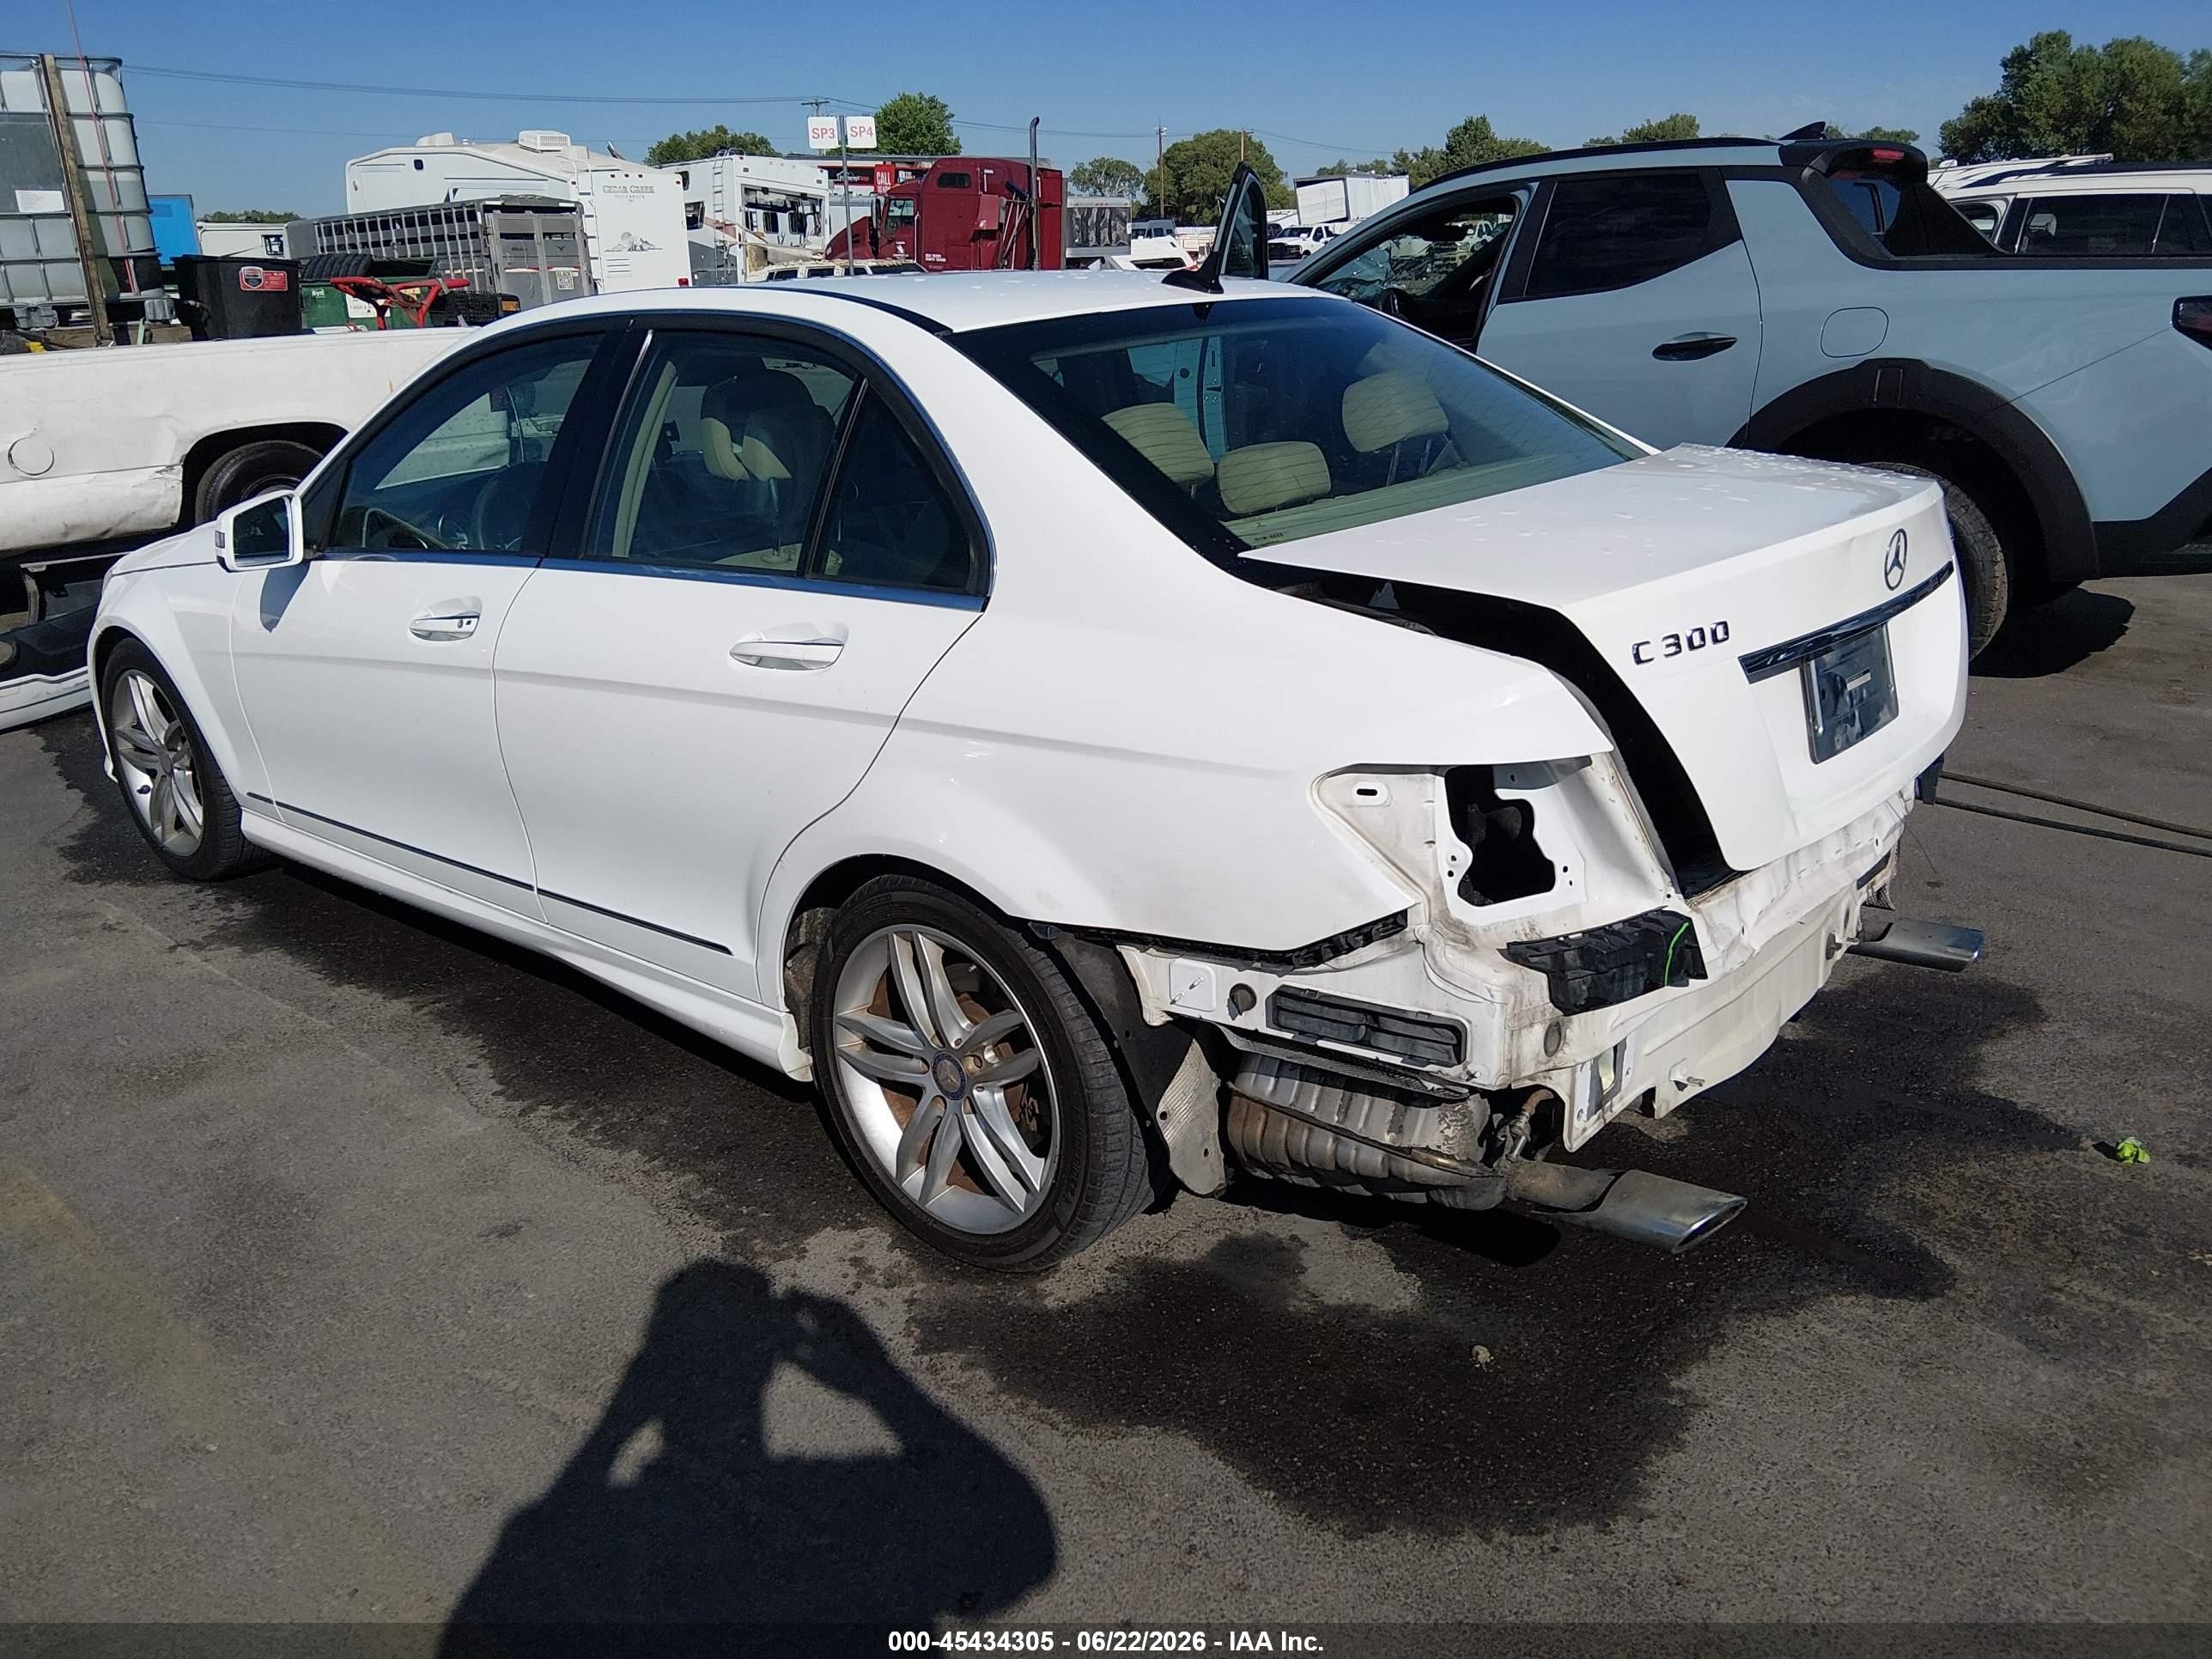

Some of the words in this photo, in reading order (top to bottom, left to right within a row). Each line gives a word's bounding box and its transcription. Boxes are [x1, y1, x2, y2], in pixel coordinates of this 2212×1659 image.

[811, 128, 835, 139] SP3
[850, 126, 873, 137] SP4
[876, 172, 891, 185] CALL
[603, 185, 629, 193] CEDAR
[629, 185, 655, 193] CREEK
[1632, 641, 1655, 665] C
[1662, 620, 1729, 658] 300
